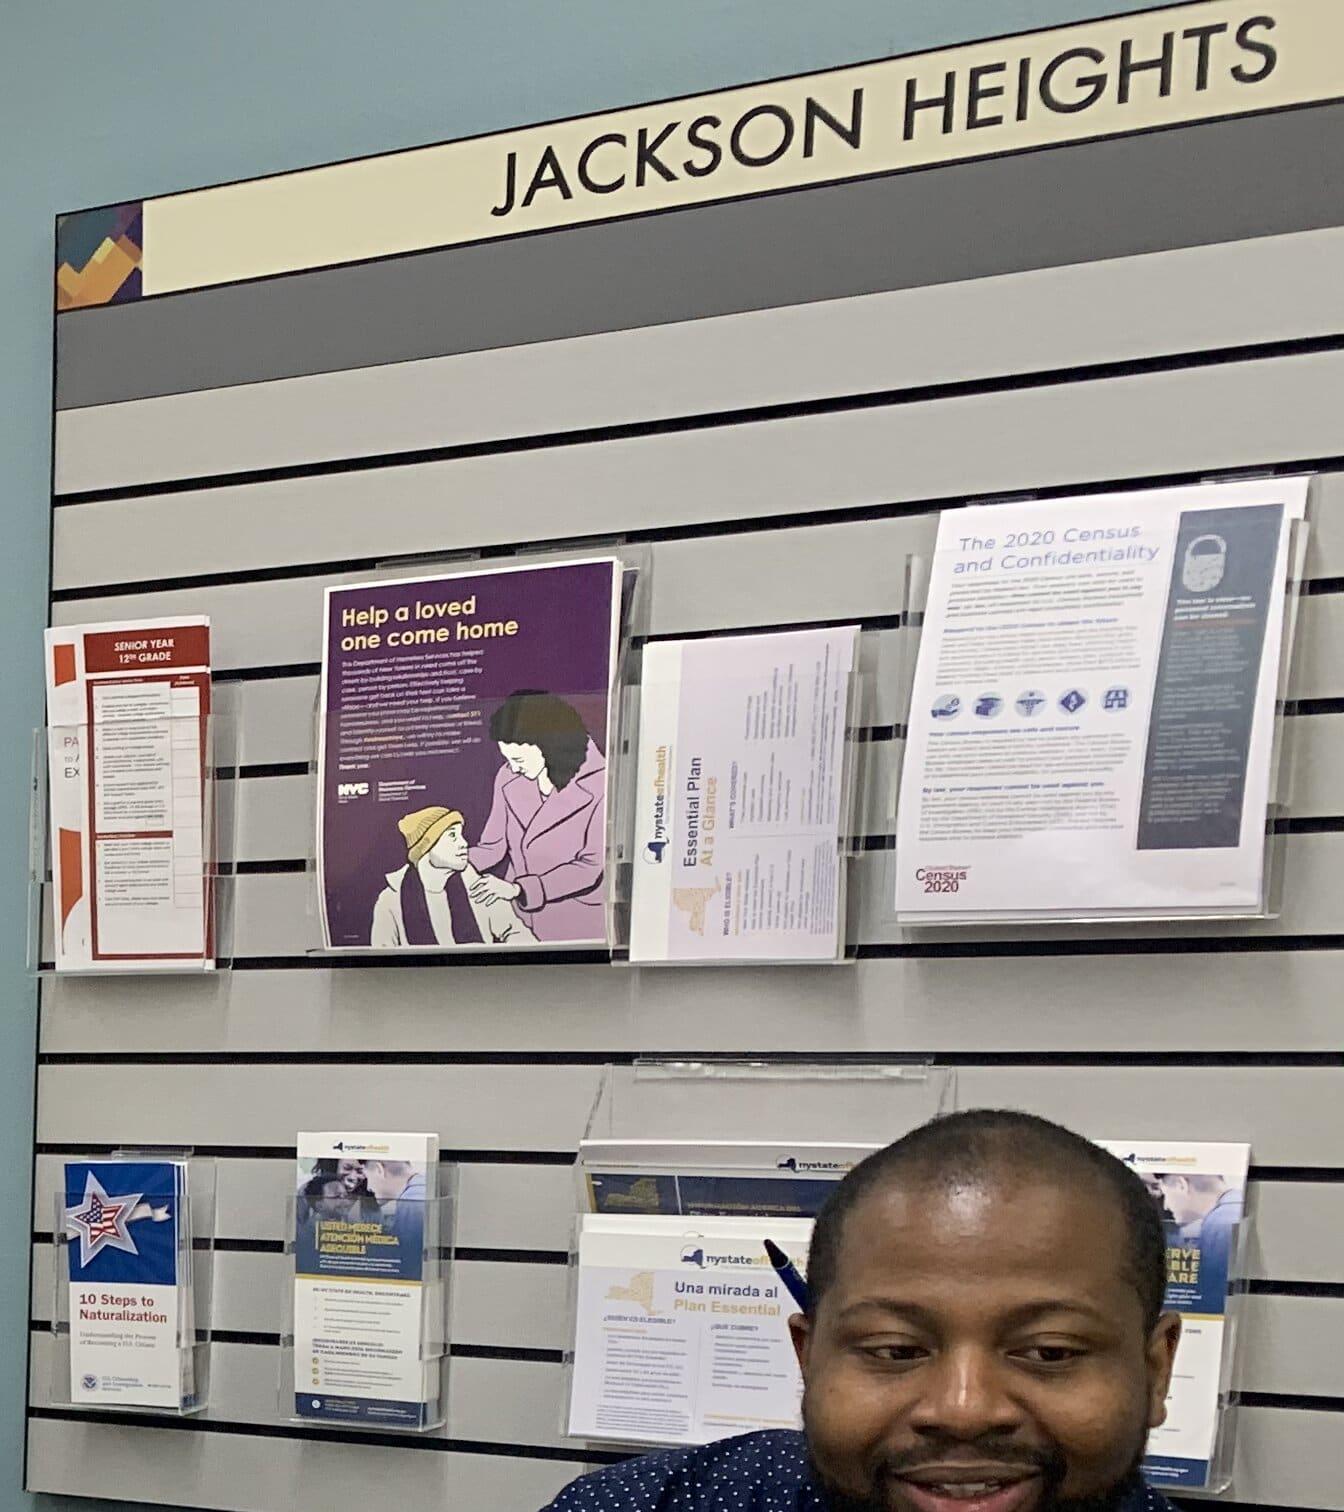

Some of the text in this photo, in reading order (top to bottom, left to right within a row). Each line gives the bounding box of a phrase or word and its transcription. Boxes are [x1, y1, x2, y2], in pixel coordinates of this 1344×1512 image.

[489, 12, 1282, 219] JACKSON HEIGHTS
[959, 524, 1142, 552] The 2020 Census
[953, 543, 1160, 574] and Confidentiality
[342, 595, 476, 628] Help a loved
[114, 638, 174, 652] SENIOR YEAR
[341, 620, 519, 651] one come home
[138, 652, 171, 662] GRADE
[338, 782, 369, 795] NYC
[654, 745, 667, 839] nystateofhealth
[684, 757, 702, 867] Essential Plan
[702, 776, 717, 831] Glance
[700, 847, 713, 866] At
[916, 868, 967, 881] Census
[924, 880, 959, 894] 2020
[674, 1281, 778, 1298] Una mirada al
[80, 1294, 154, 1307] 10 Steps to
[674, 1298, 781, 1317] Plan Essential
[80, 1310, 167, 1323] Naturalization
